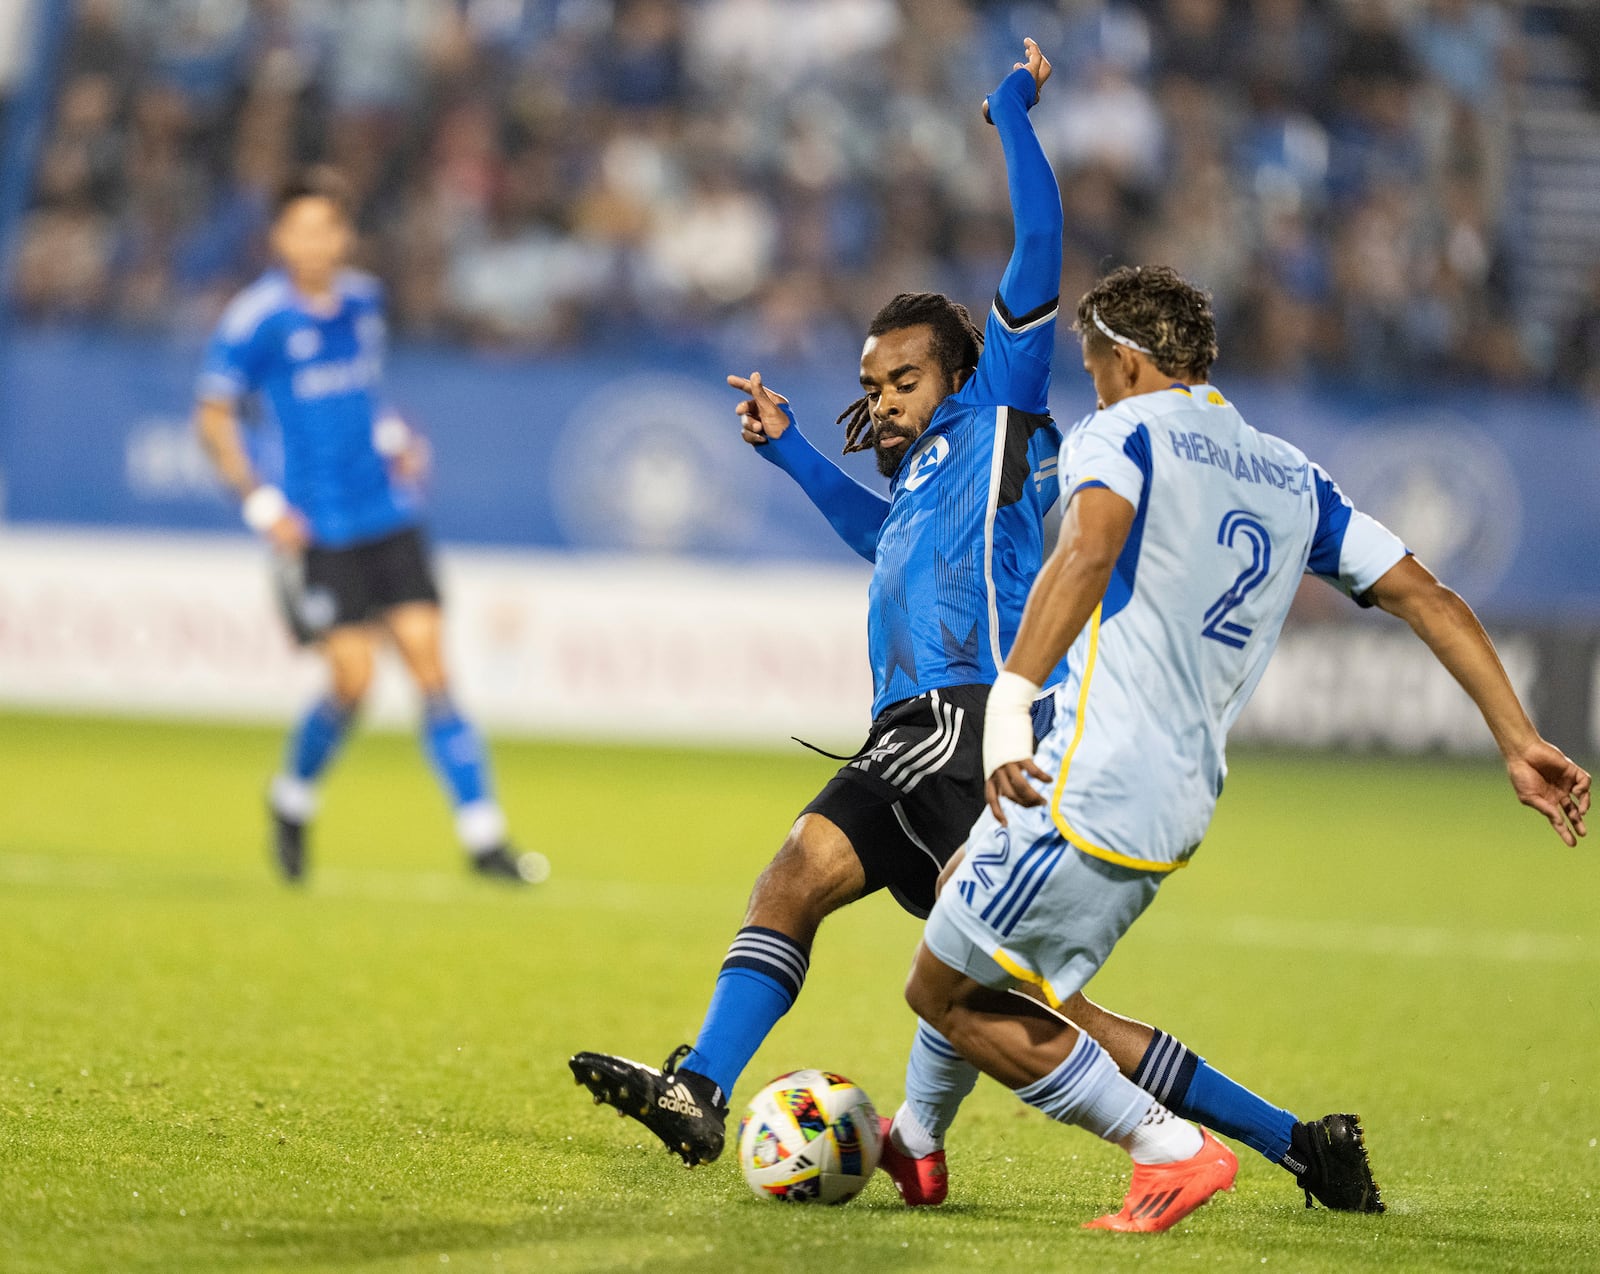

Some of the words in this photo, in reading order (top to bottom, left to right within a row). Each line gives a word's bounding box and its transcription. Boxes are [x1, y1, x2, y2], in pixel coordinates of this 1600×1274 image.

[1168, 429, 1312, 496] HERNÁNDEZ
[1201, 509, 1272, 651] 2
[971, 825, 1011, 891] 2
[657, 1095, 704, 1119] adidas
